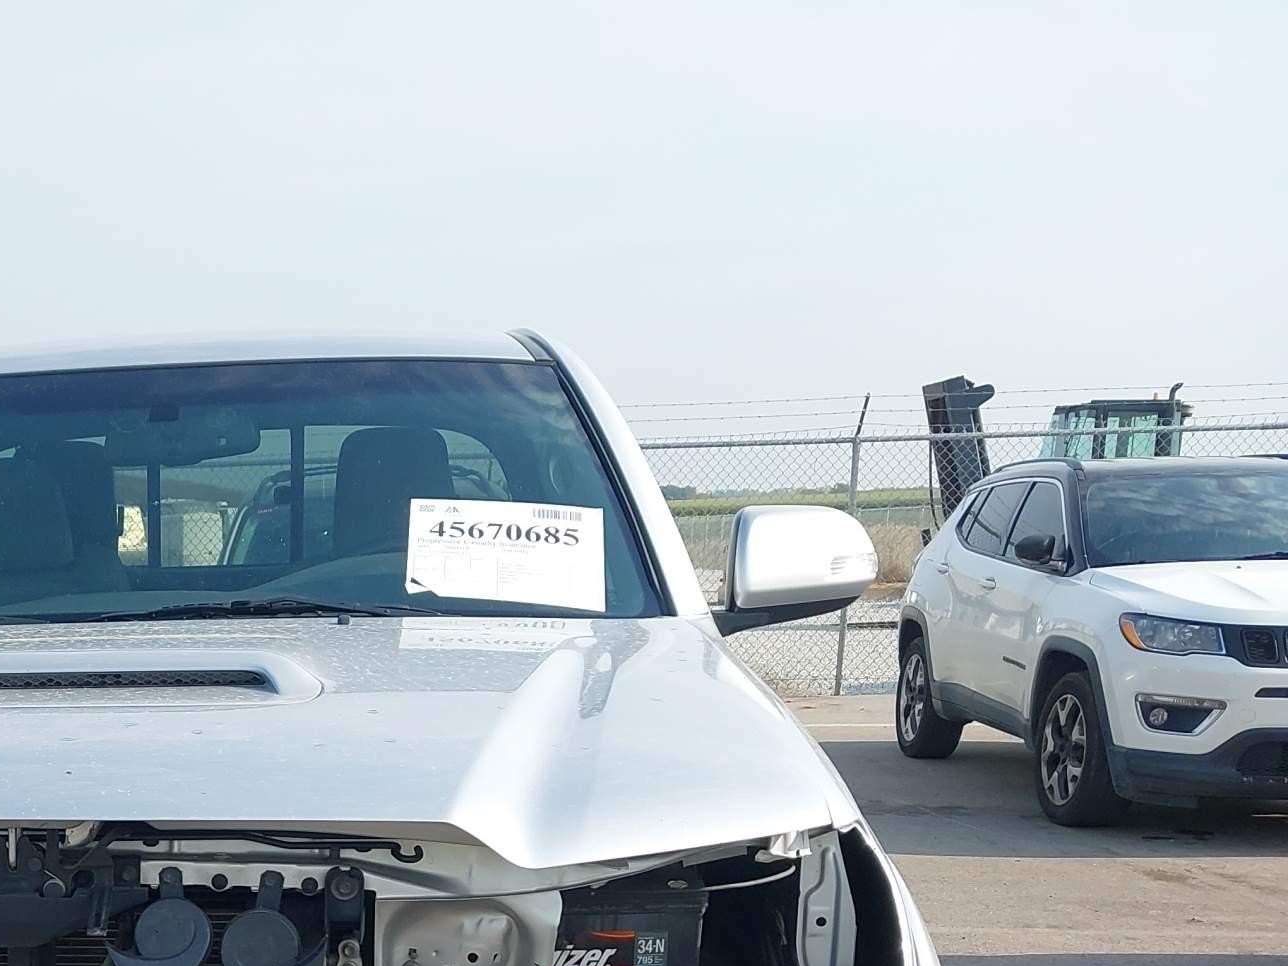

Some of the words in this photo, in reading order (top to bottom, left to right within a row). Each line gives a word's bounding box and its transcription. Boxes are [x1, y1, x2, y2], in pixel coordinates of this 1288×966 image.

[429, 520, 580, 546] 45670685
[637, 939, 665, 954] 34-N
[636, 956, 654, 966] 795
